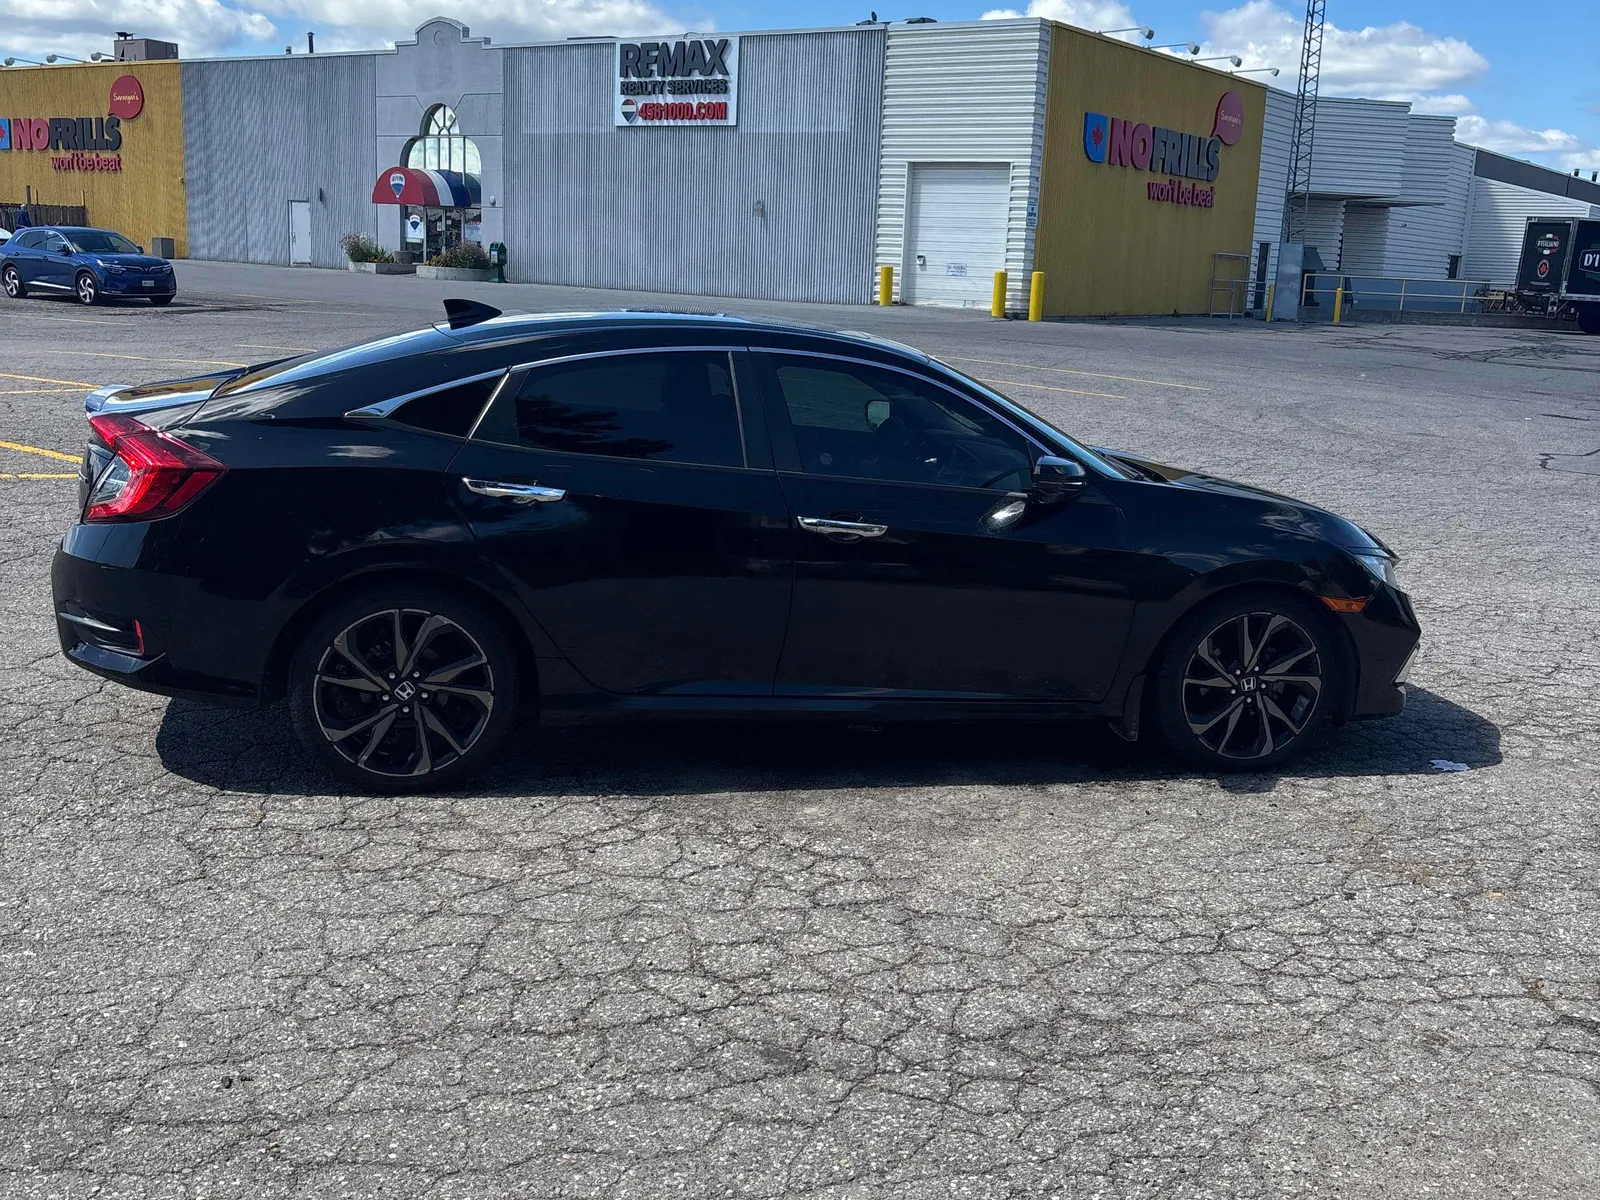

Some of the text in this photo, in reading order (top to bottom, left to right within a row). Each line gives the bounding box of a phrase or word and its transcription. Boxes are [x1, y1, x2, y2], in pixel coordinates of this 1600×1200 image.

[620, 39, 729, 78] REMAX
[621, 79, 728, 95] REALTY SERVICES
[52, 153, 121, 171] won't be beat
[1147, 179, 1215, 208] won't be beat
